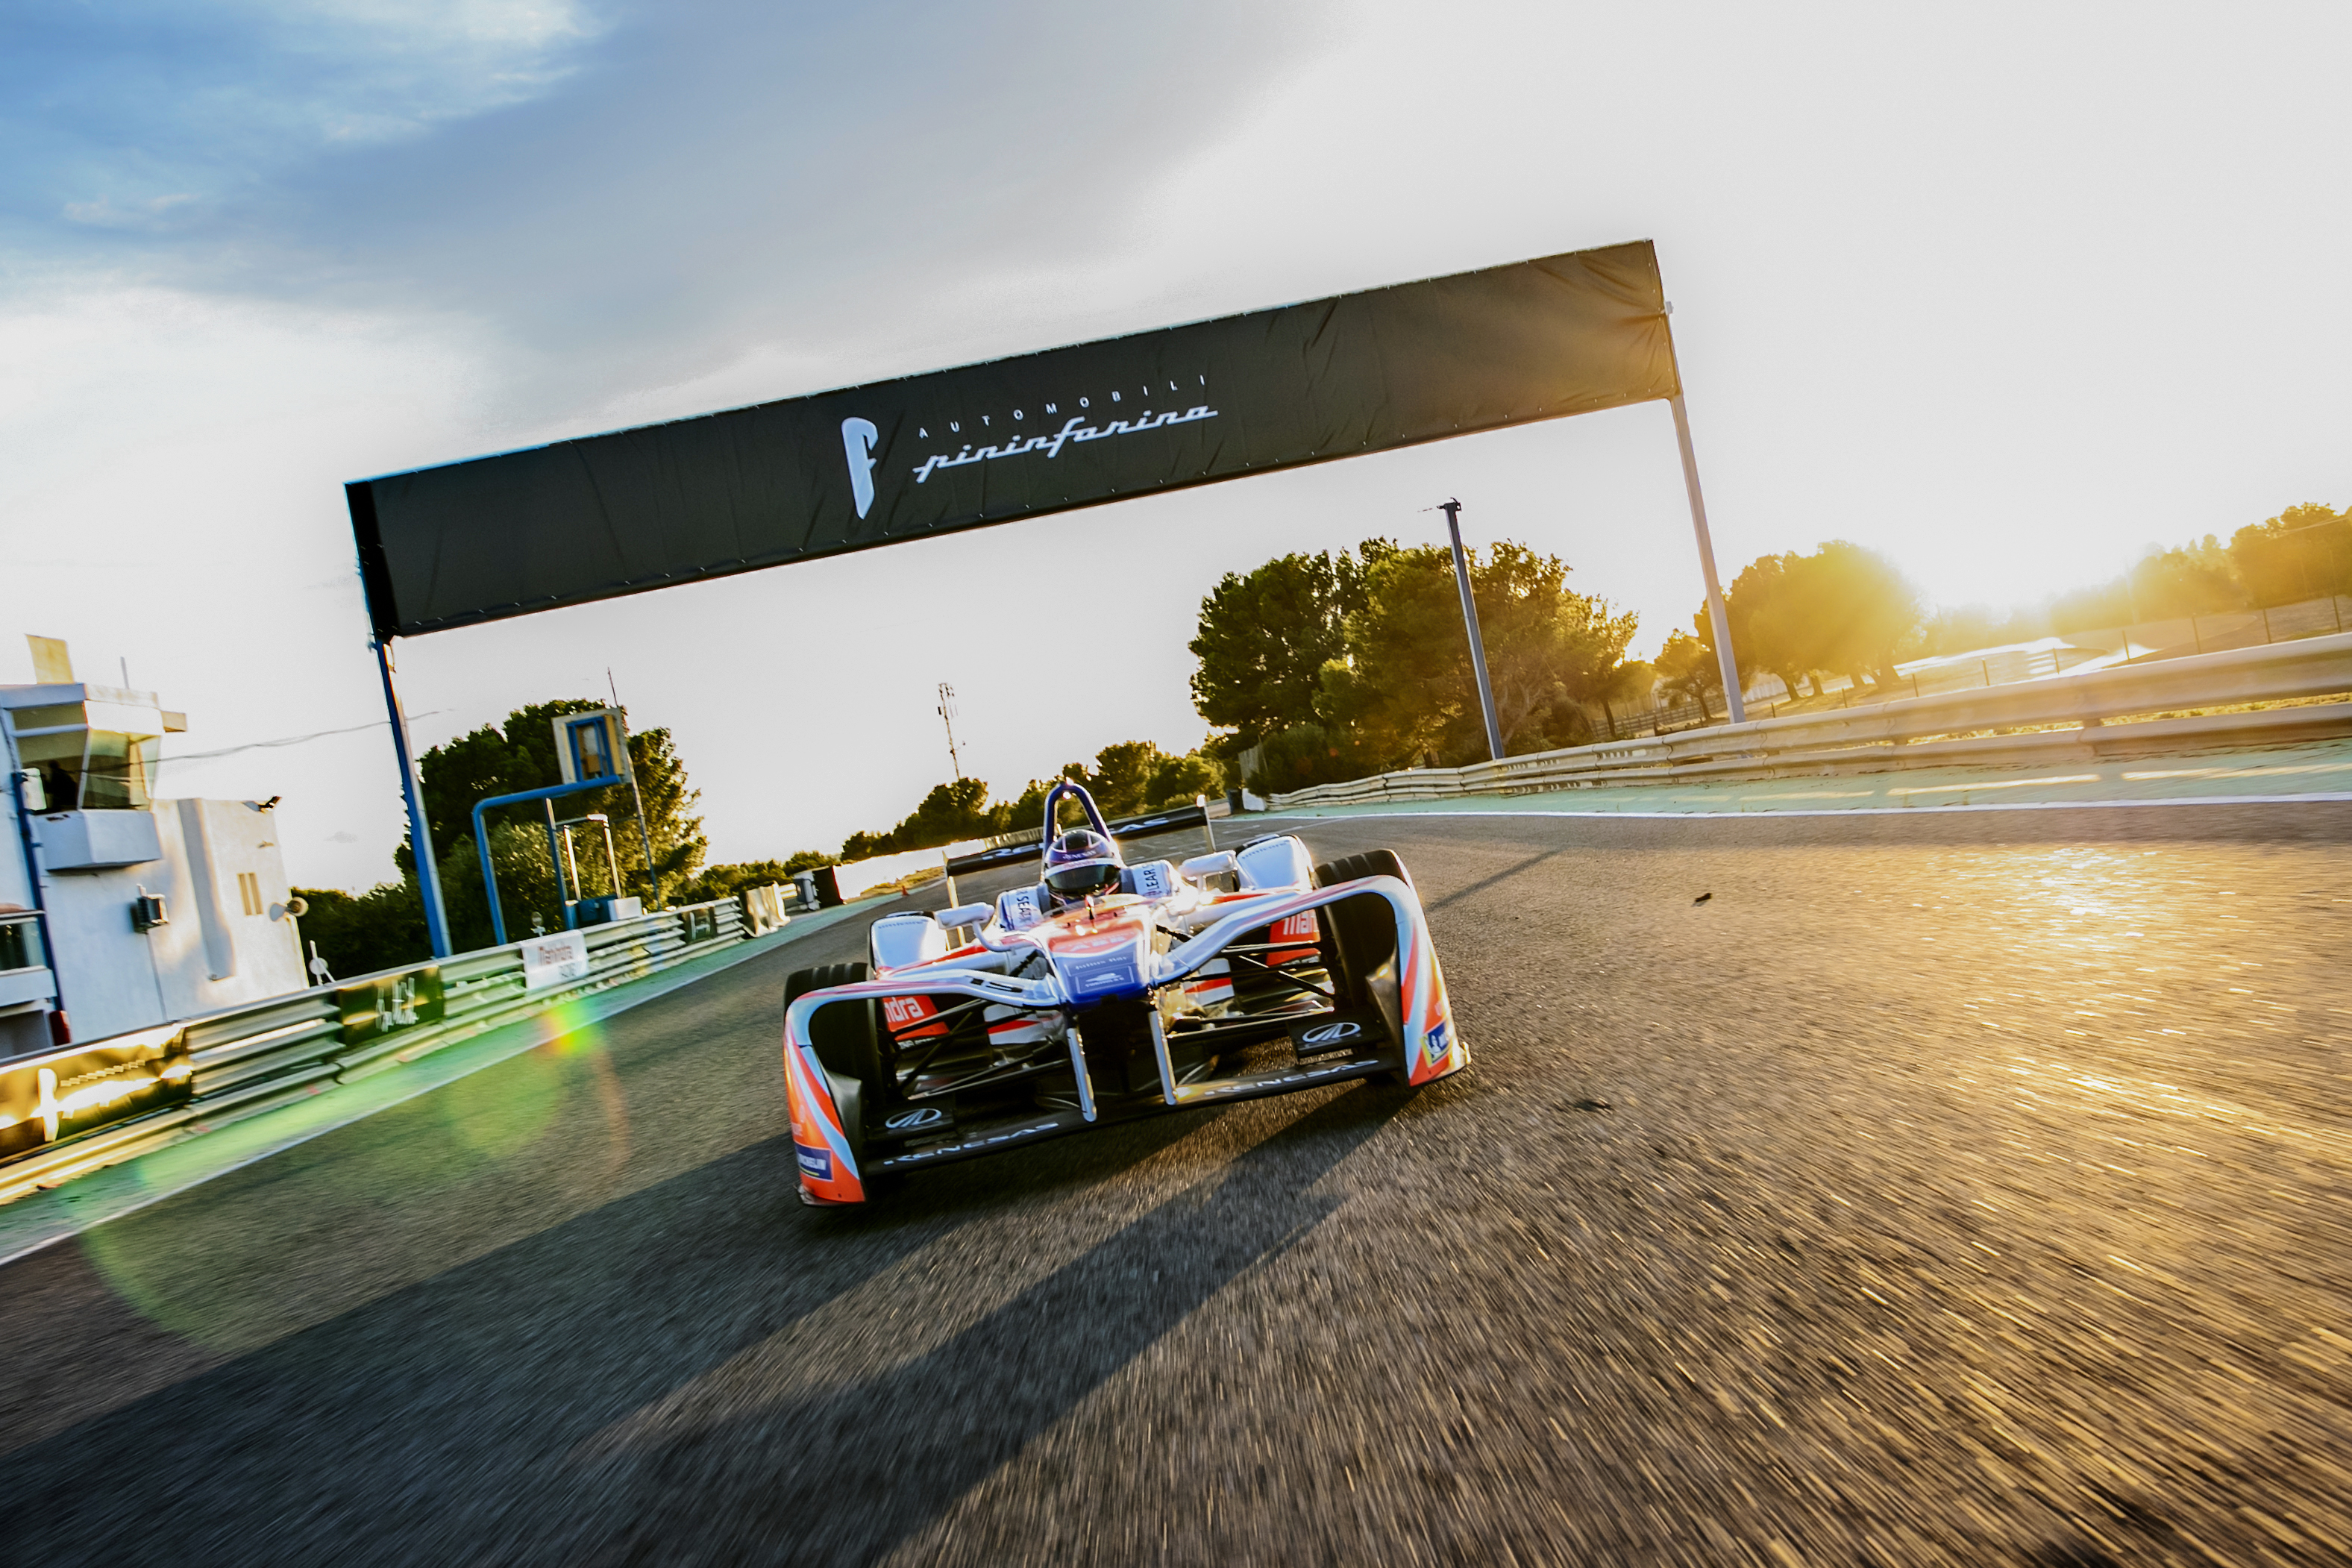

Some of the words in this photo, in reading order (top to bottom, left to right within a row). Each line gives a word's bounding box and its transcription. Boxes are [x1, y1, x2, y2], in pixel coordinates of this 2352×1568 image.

[918, 374, 1205, 439] AUTOMOBILI
[912, 405, 1220, 484] pininfarina
[1142, 868, 1161, 891] LEAR
